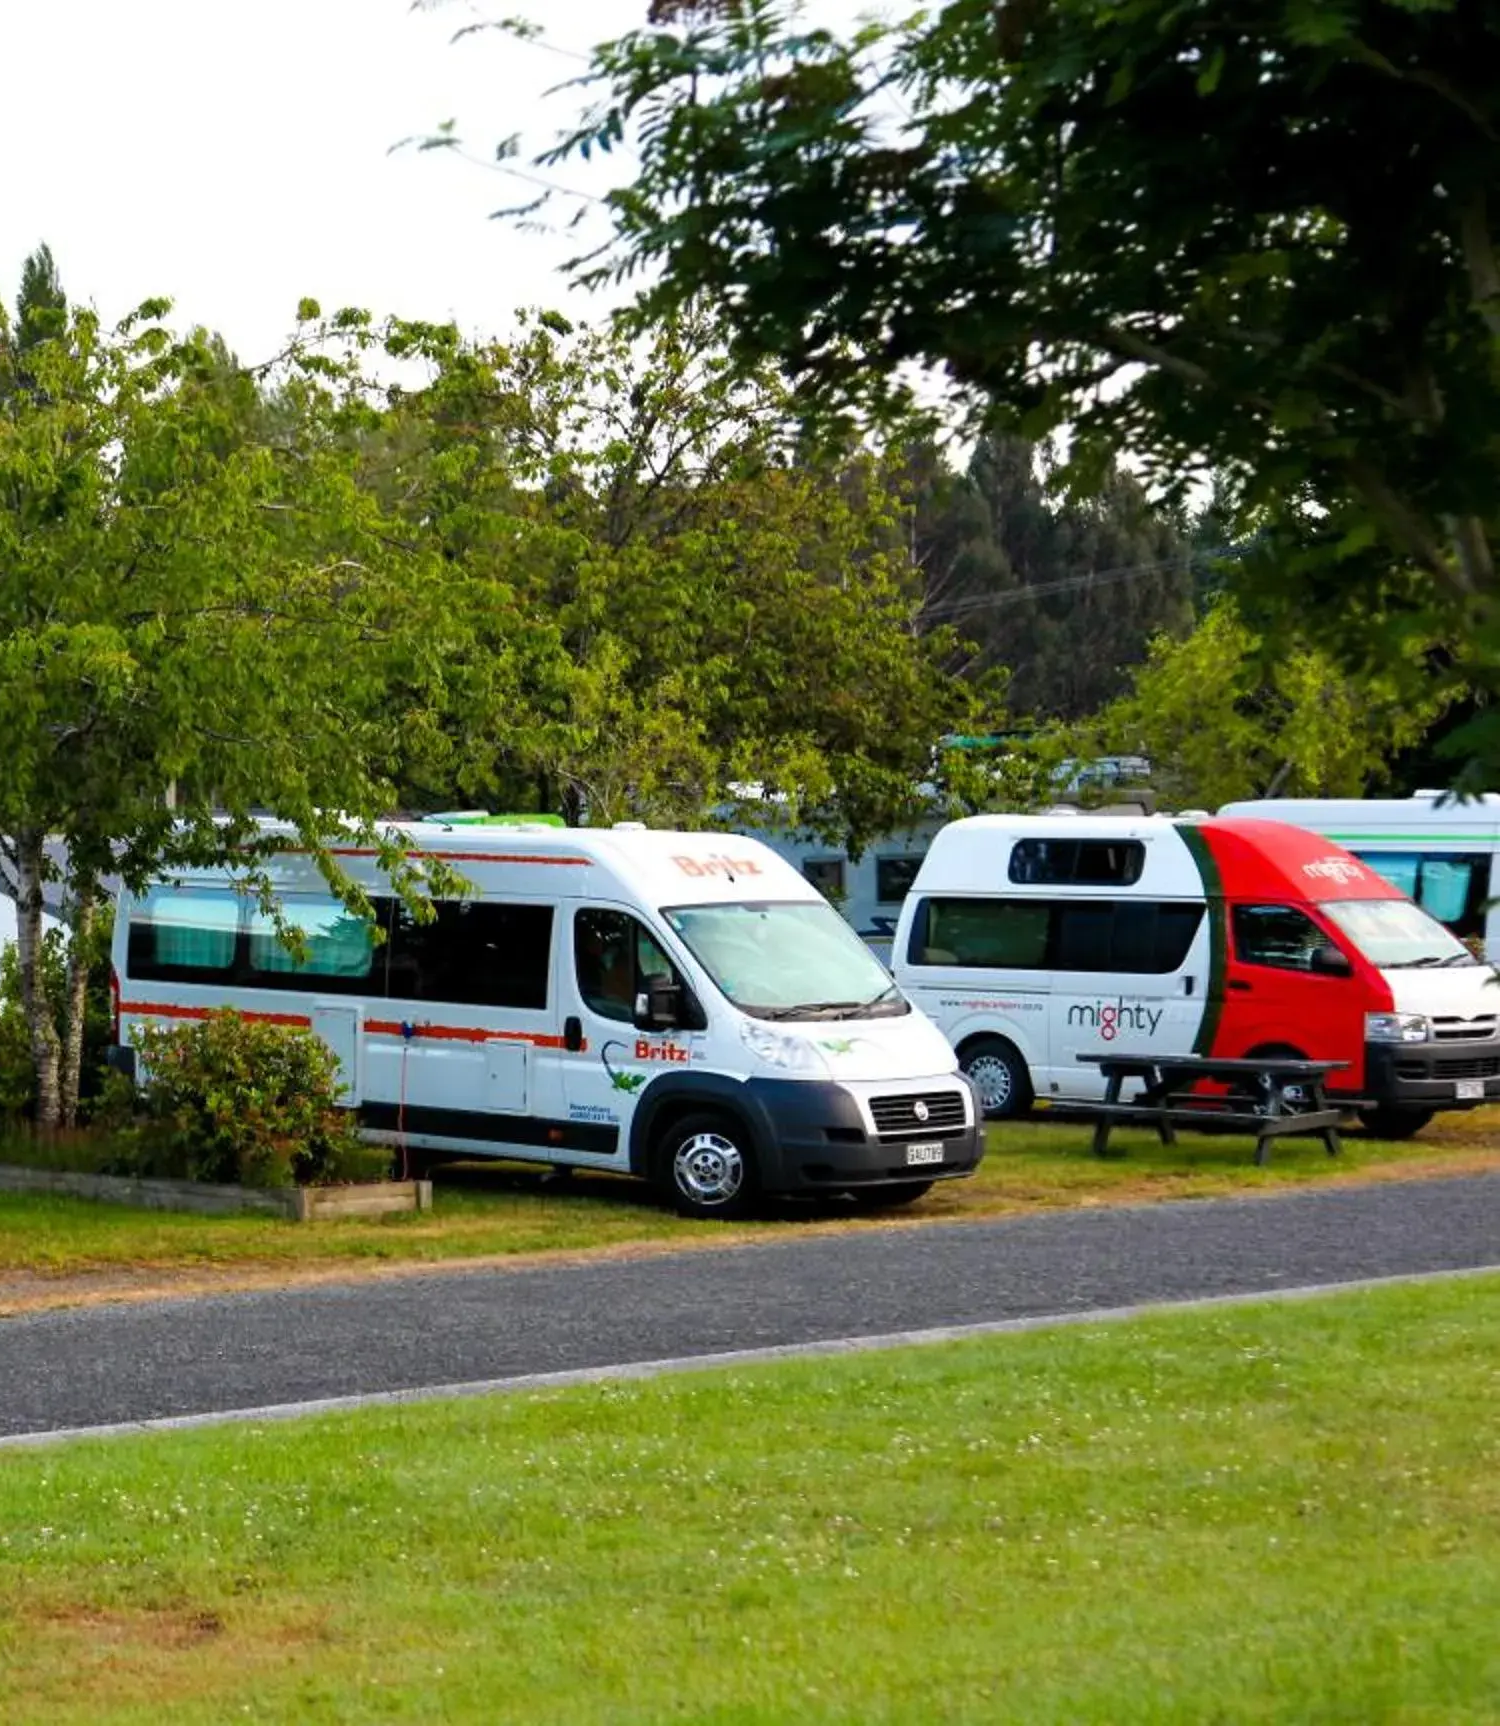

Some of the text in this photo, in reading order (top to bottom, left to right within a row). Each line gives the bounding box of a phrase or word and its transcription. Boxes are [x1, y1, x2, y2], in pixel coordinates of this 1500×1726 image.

[669, 853, 764, 877] Britz
[1067, 995, 1163, 1041] mighty
[635, 1039, 688, 1062] Britz
